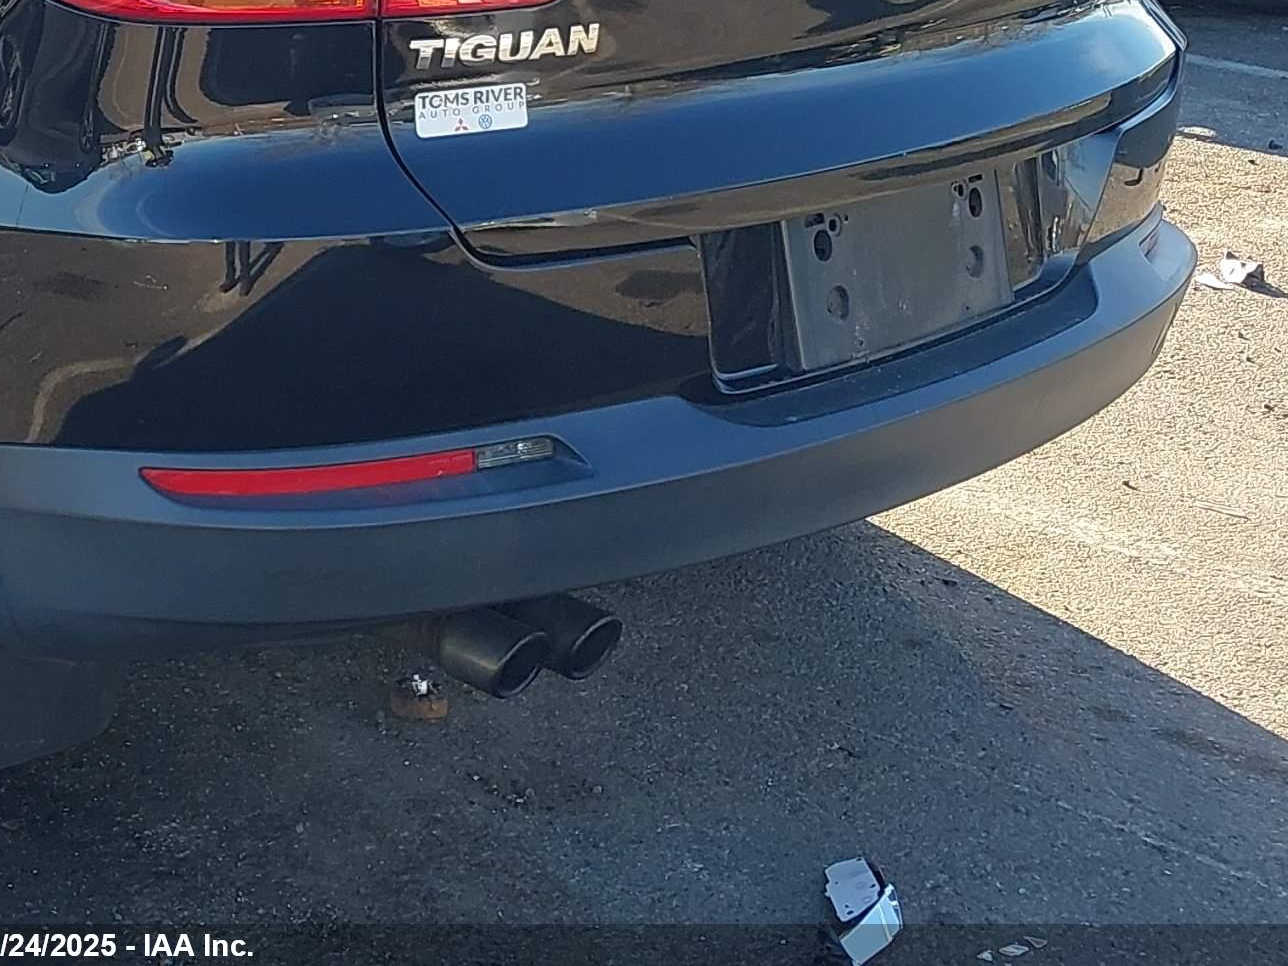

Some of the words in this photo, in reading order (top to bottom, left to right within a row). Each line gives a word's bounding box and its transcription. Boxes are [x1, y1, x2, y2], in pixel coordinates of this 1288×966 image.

[409, 23, 600, 70] TIGUAN
[418, 91, 470, 109] TOMS
[472, 86, 525, 104] RIVER
[418, 108, 462, 120] AUTO
[472, 100, 526, 115] GROUP
